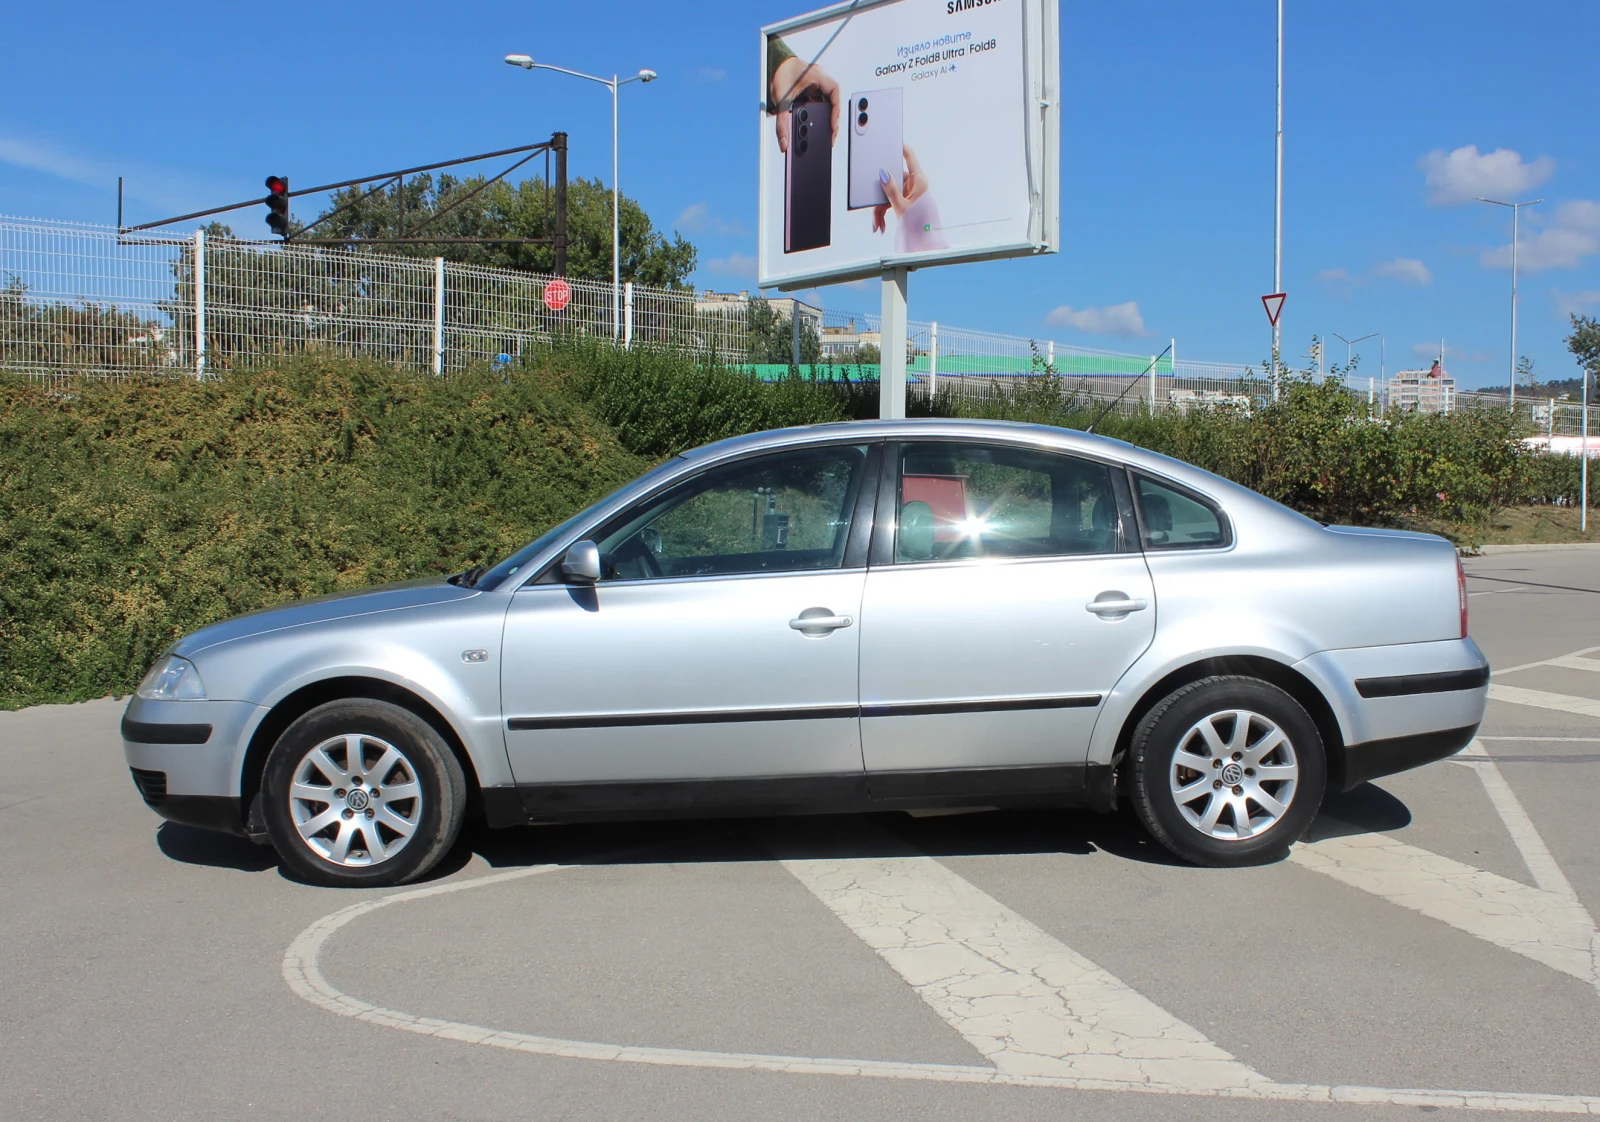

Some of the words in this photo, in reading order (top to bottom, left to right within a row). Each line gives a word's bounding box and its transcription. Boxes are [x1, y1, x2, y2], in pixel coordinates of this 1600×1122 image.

[897, 41, 931, 58] Изцяло
[932, 31, 972, 48] новите
[875, 61, 907, 77] Galaxy
[908, 59, 914, 69] Z
[915, 52, 941, 67] Fold8
[942, 48, 965, 60] Ultra
[969, 39, 996, 54] Fold8
[911, 69, 939, 82] Galaxy
[546, 290, 568, 302] STOP
